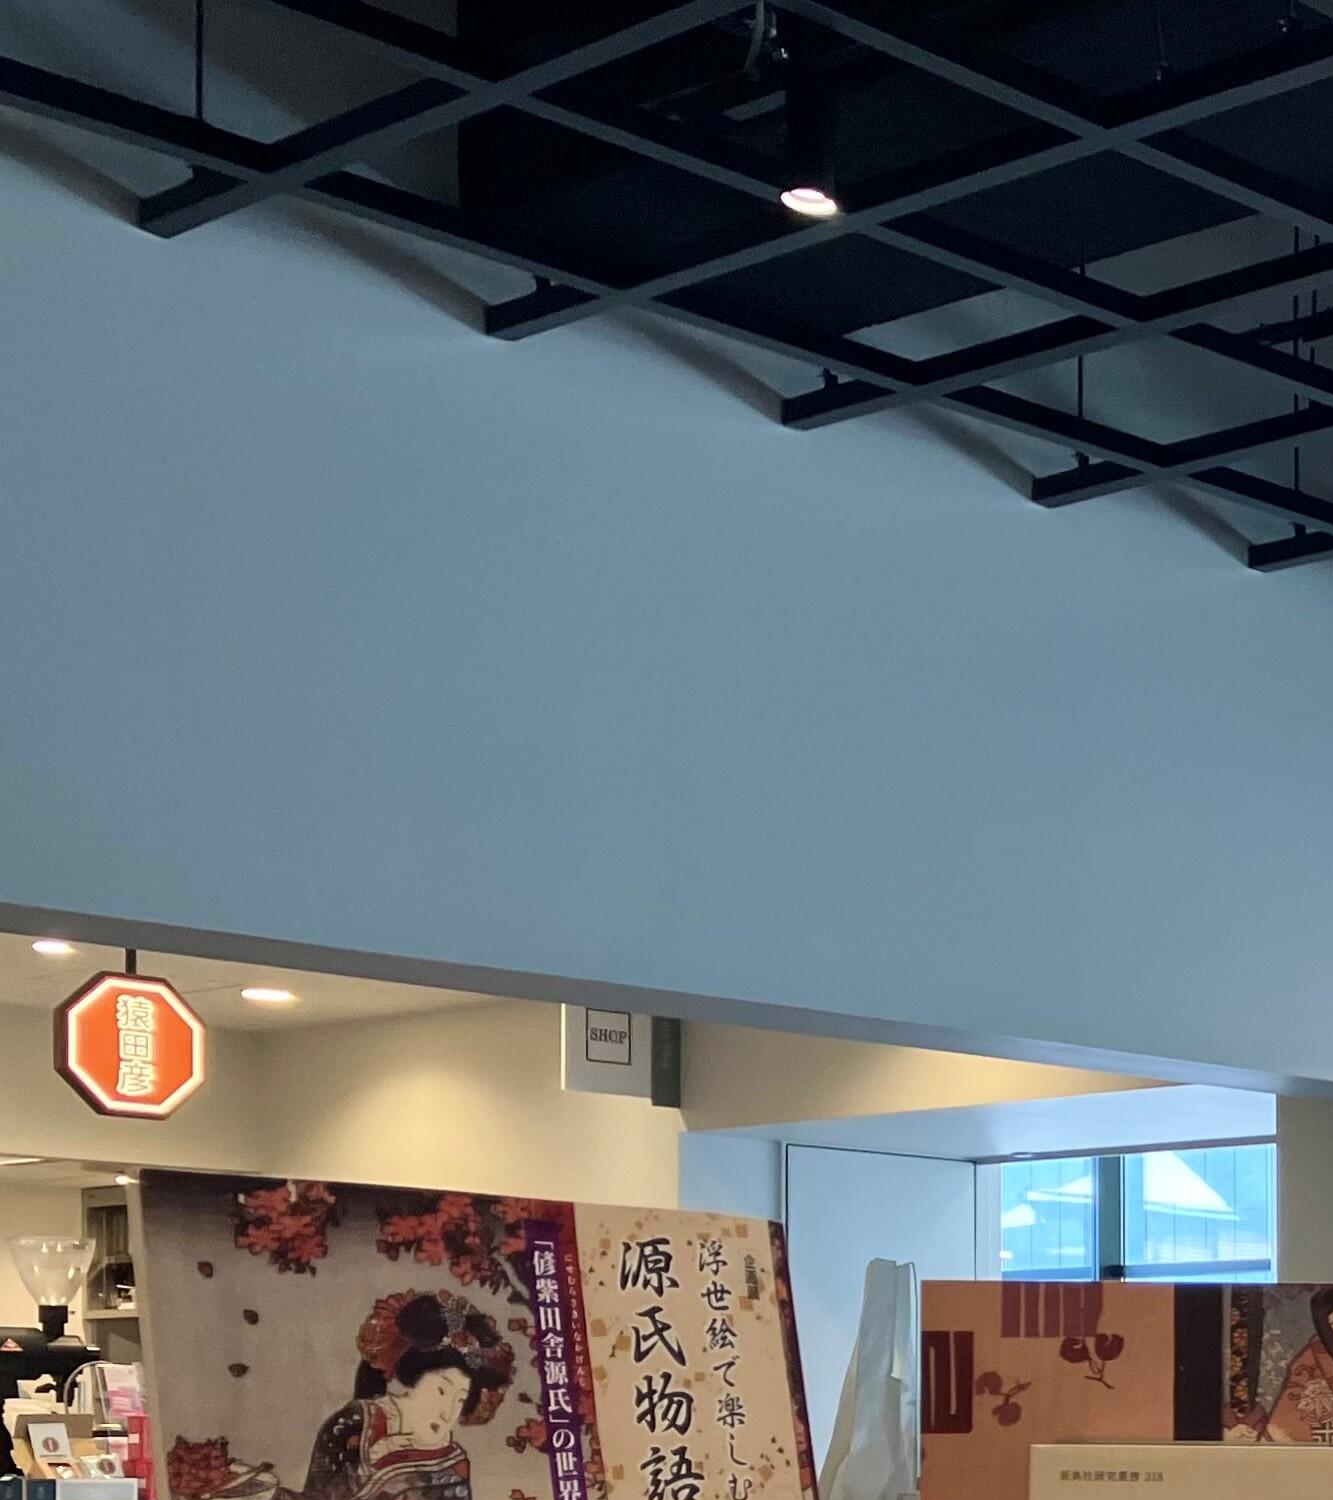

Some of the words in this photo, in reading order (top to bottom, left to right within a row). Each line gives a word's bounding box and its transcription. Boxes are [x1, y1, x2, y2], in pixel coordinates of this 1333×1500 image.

[117, 995, 154, 1096] 猿田彦
[589, 1027, 627, 1044] SHOP
